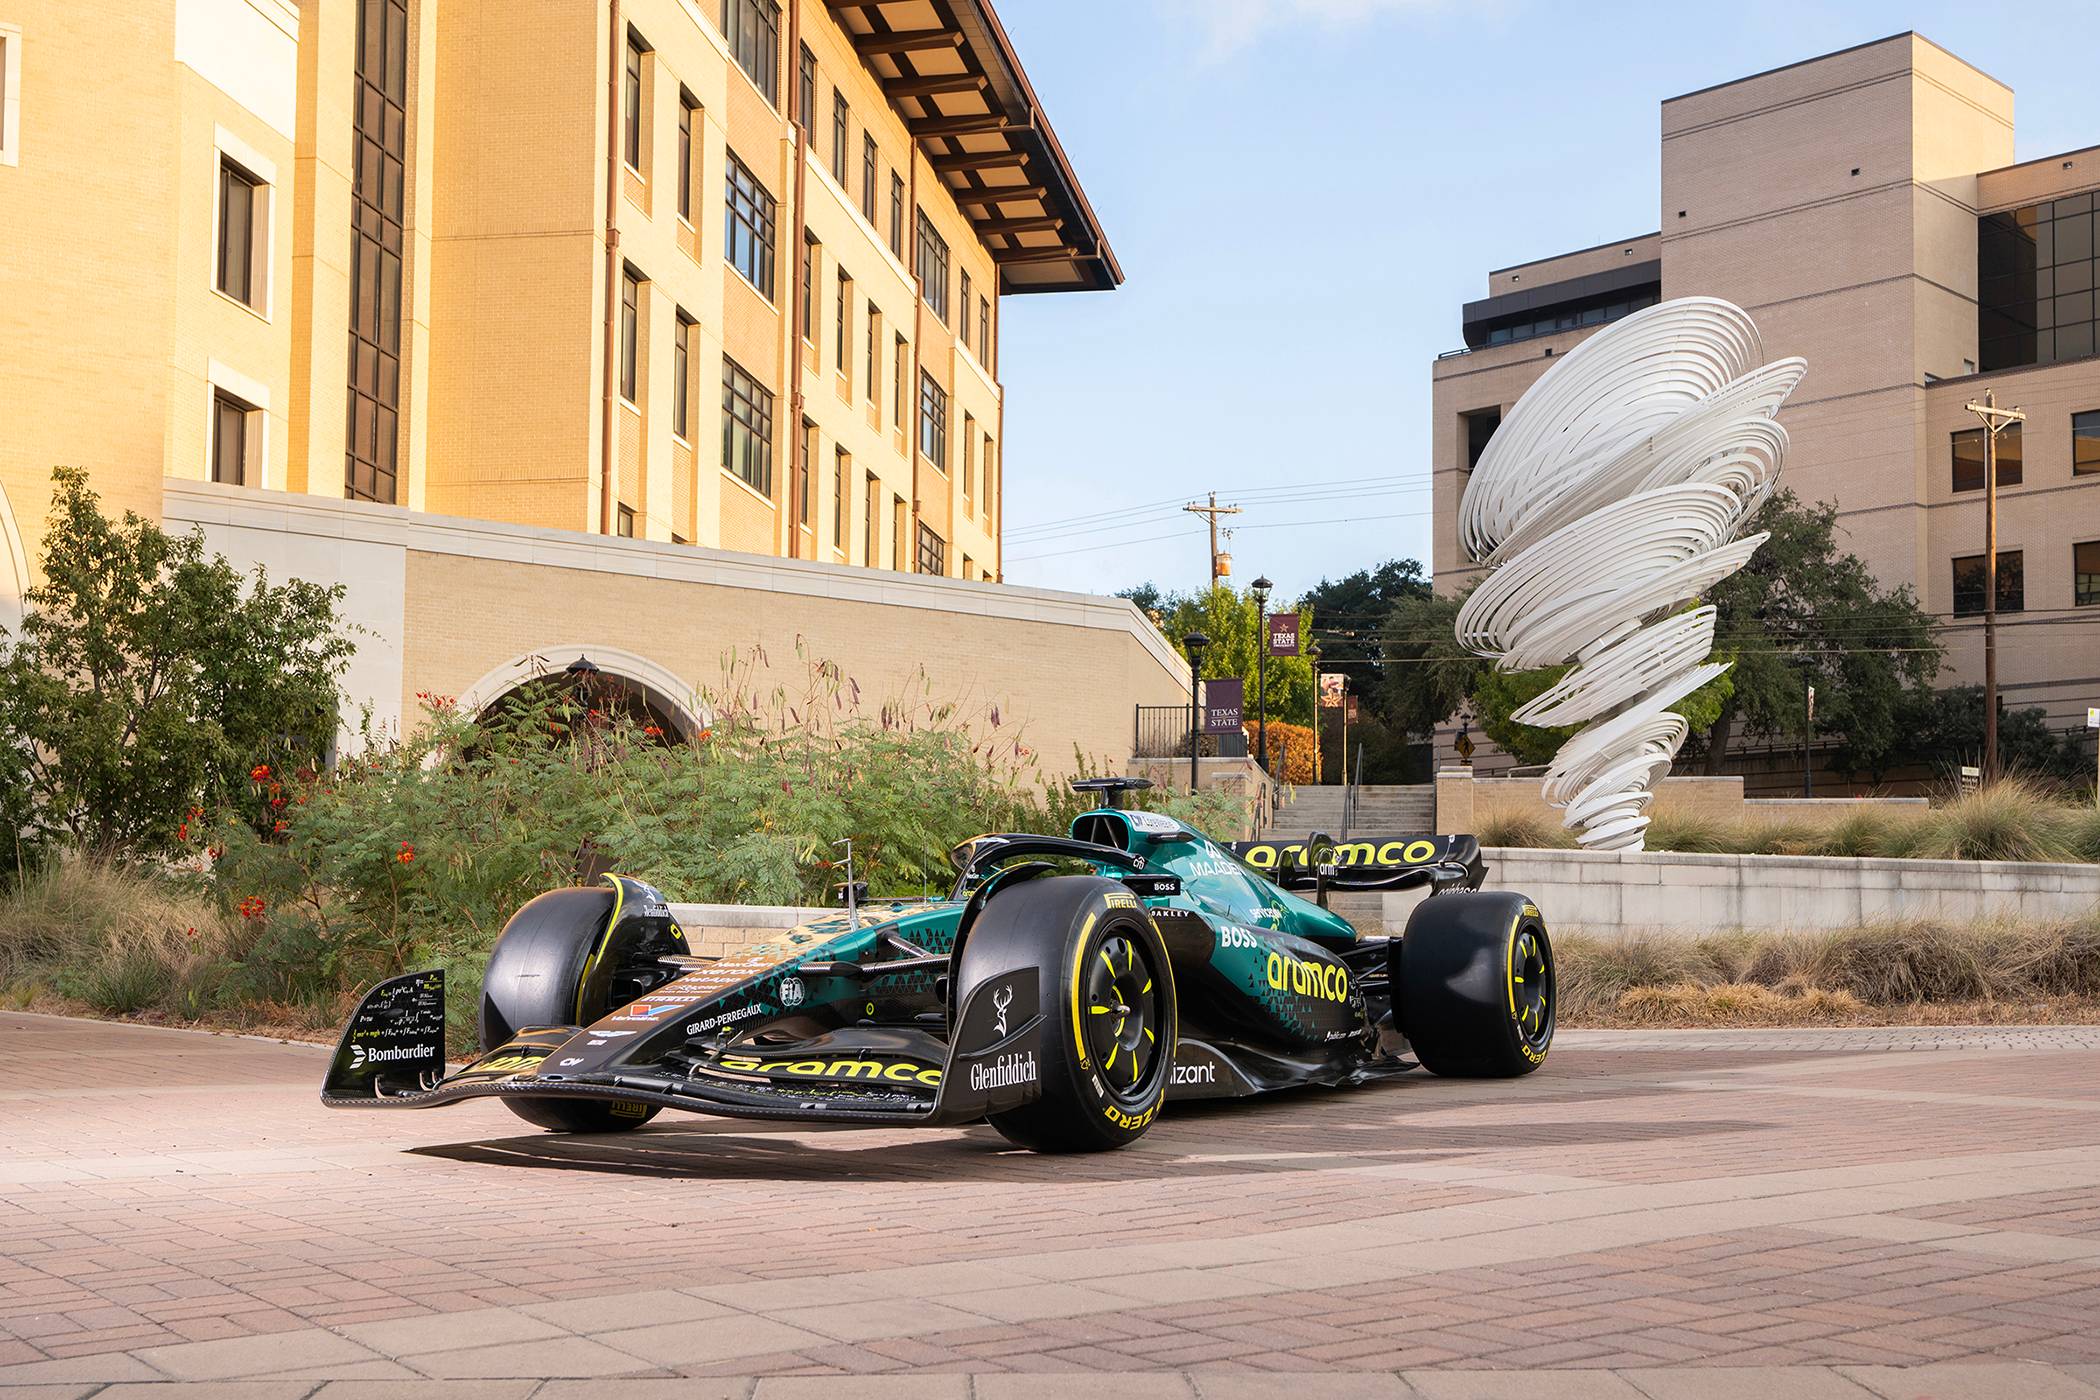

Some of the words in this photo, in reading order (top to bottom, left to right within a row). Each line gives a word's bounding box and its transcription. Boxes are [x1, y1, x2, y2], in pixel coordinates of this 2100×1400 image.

[1211, 708, 1239, 717] TEXAS
[1211, 719, 1238, 727] STATE
[1245, 840, 1436, 867] armco
[1154, 883, 1175, 891] BOSS
[1104, 893, 1137, 908] PIRELLI
[1220, 926, 1257, 948] BOSS
[1268, 952, 1347, 1003] aramco
[782, 983, 802, 998] FIA
[687, 1003, 762, 1035] GIRARD-PERREGAUX
[368, 1043, 435, 1062] Bombardier
[1522, 1044, 1548, 1064] ZERO
[970, 1051, 1037, 1091] Glenfiddich
[1104, 1105, 1154, 1130] ZERO
